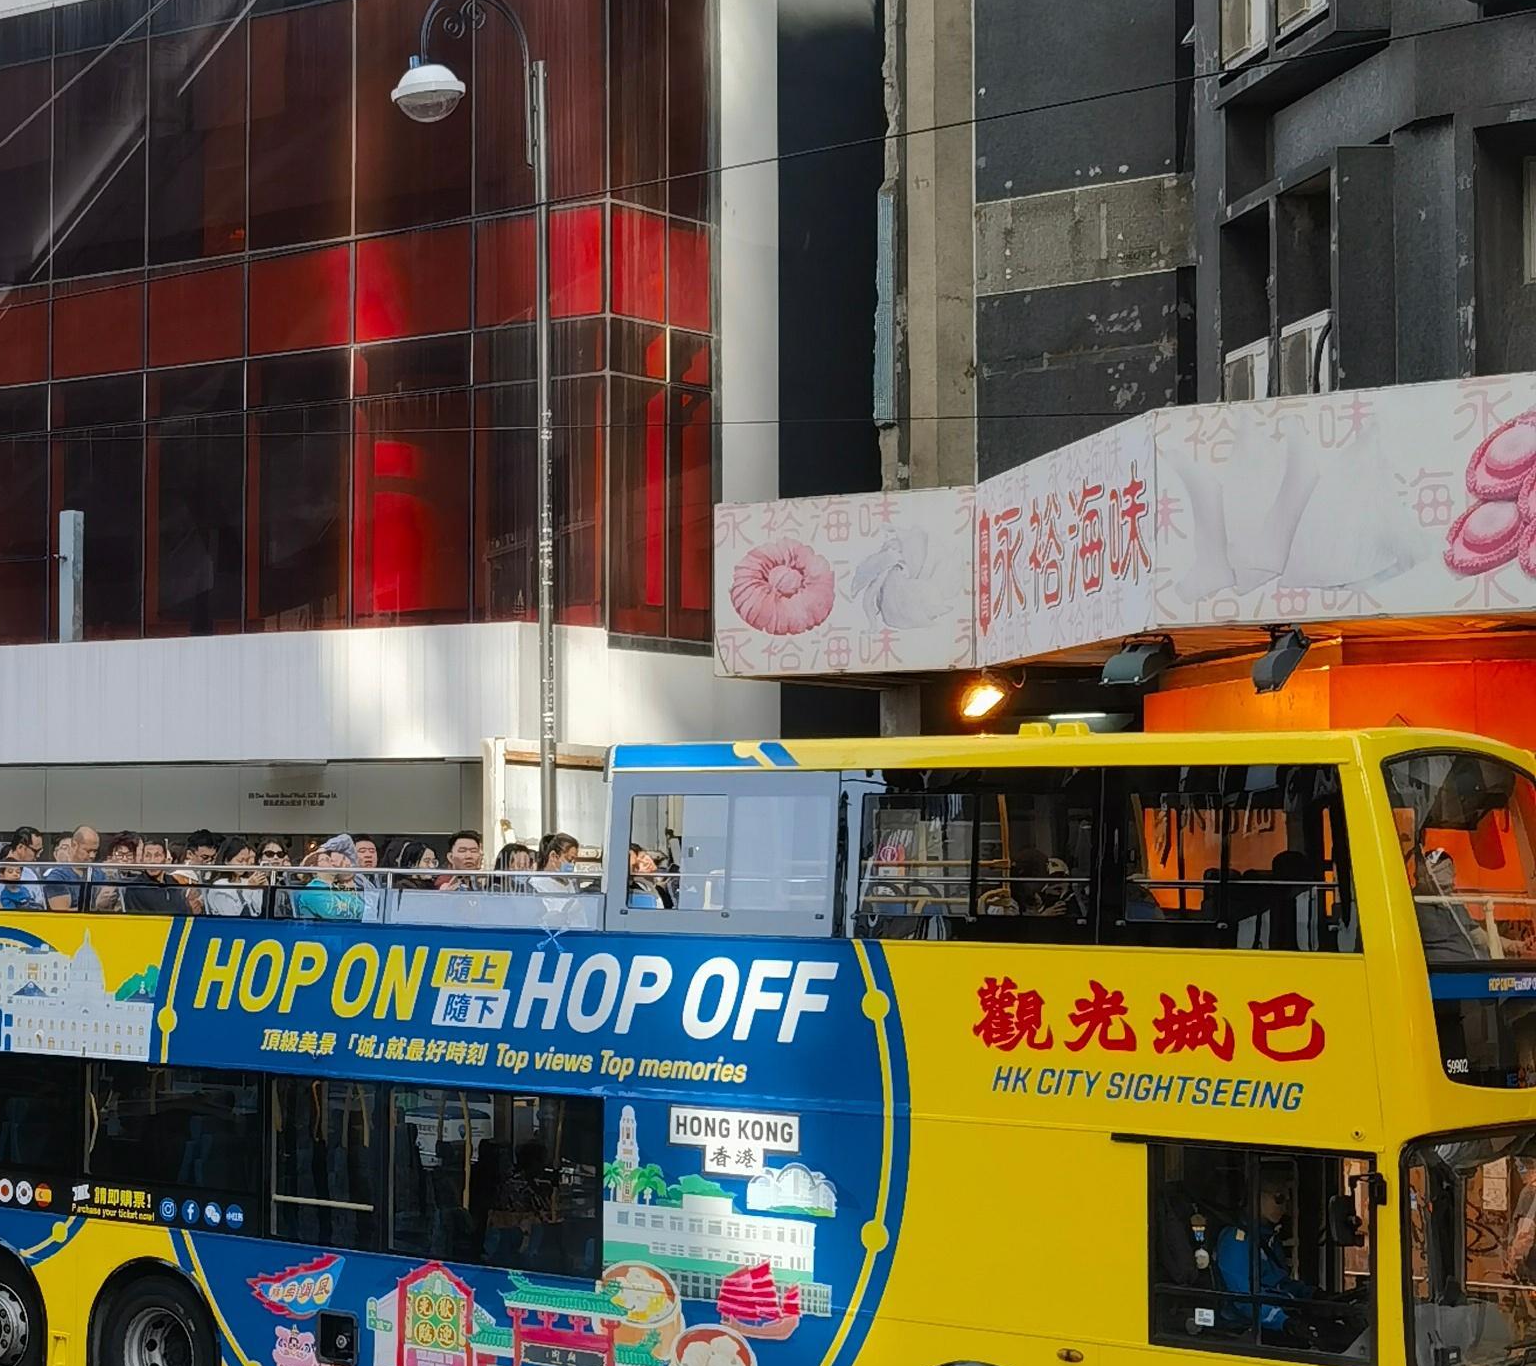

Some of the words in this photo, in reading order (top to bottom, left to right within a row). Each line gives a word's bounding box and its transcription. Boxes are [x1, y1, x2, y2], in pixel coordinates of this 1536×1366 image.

[993, 459, 1152, 621] 永裕海味
[193, 939, 327, 1013] HOP
[332, 943, 430, 1020] ON
[444, 954, 498, 984] 隨上
[443, 993, 499, 1024] 隨下
[514, 951, 673, 1033] HOP
[682, 957, 839, 1043] OFF
[972, 976, 1326, 1062] 觀光城巴
[260, 1029, 337, 1056] 頂級美景
[496, 1043, 529, 1074] Top
[535, 1046, 593, 1073] views
[600, 1049, 635, 1081] Top
[638, 1056, 748, 1083] memories
[1447, 1058, 1469, 1074] 59902
[992, 1066, 1032, 1093] HK
[1037, 1068, 1102, 1097] CITY
[1106, 1071, 1305, 1111] SIGHTSEEING
[675, 1115, 730, 1138] HONG
[738, 1119, 793, 1143] KONG
[709, 1146, 757, 1168] 香港
